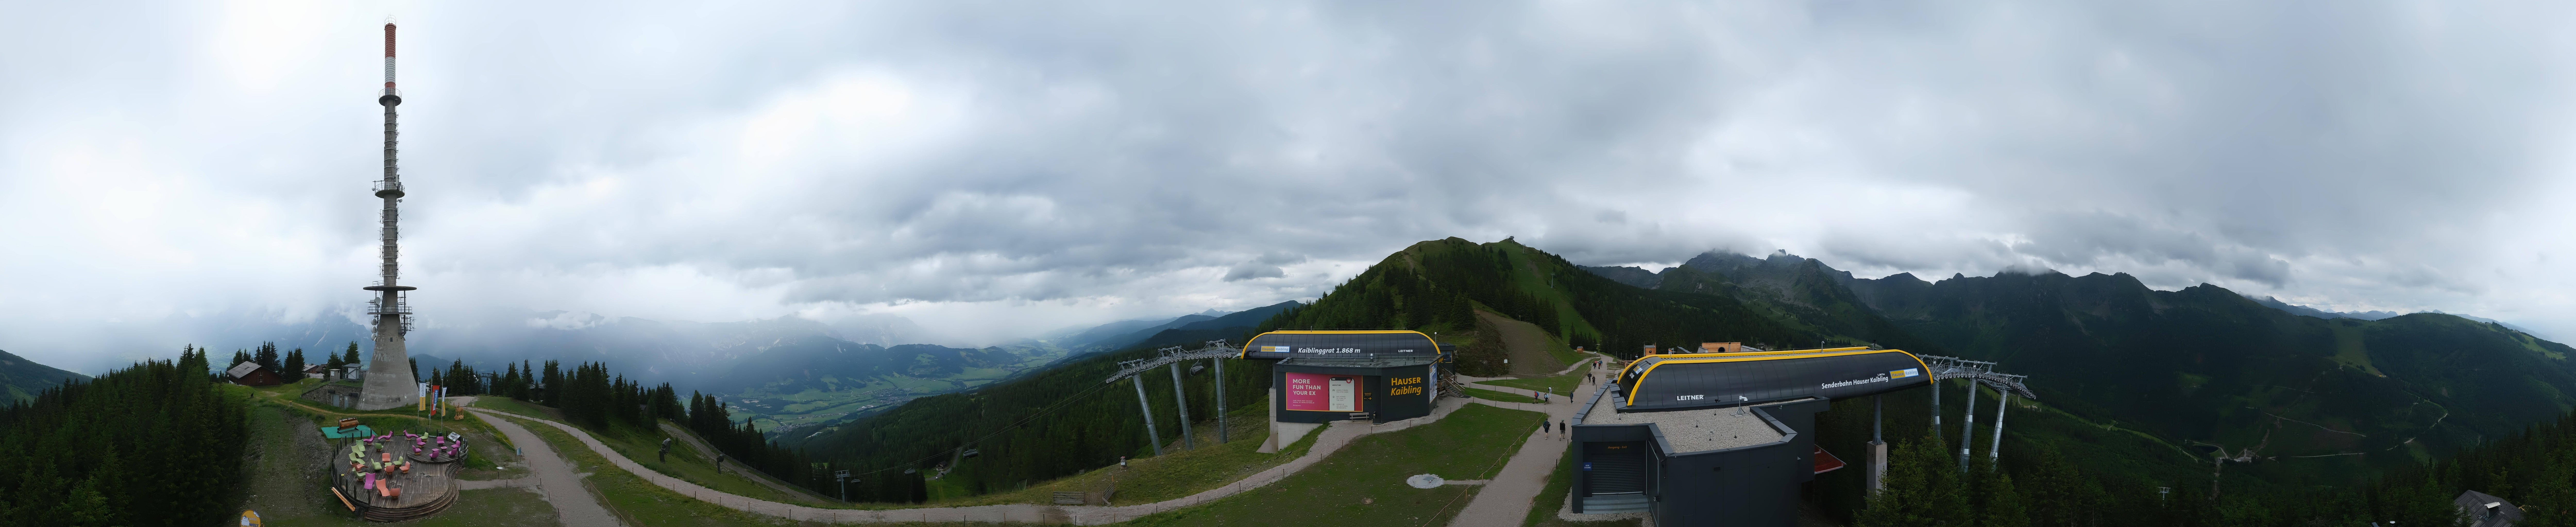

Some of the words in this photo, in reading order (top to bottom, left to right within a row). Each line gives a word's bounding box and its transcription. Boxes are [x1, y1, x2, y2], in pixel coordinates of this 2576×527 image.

[1391, 377, 1421, 386] HAUSER
[1822, 380, 1852, 389] Senderbahn
[1391, 386, 1421, 396] Kaibling
